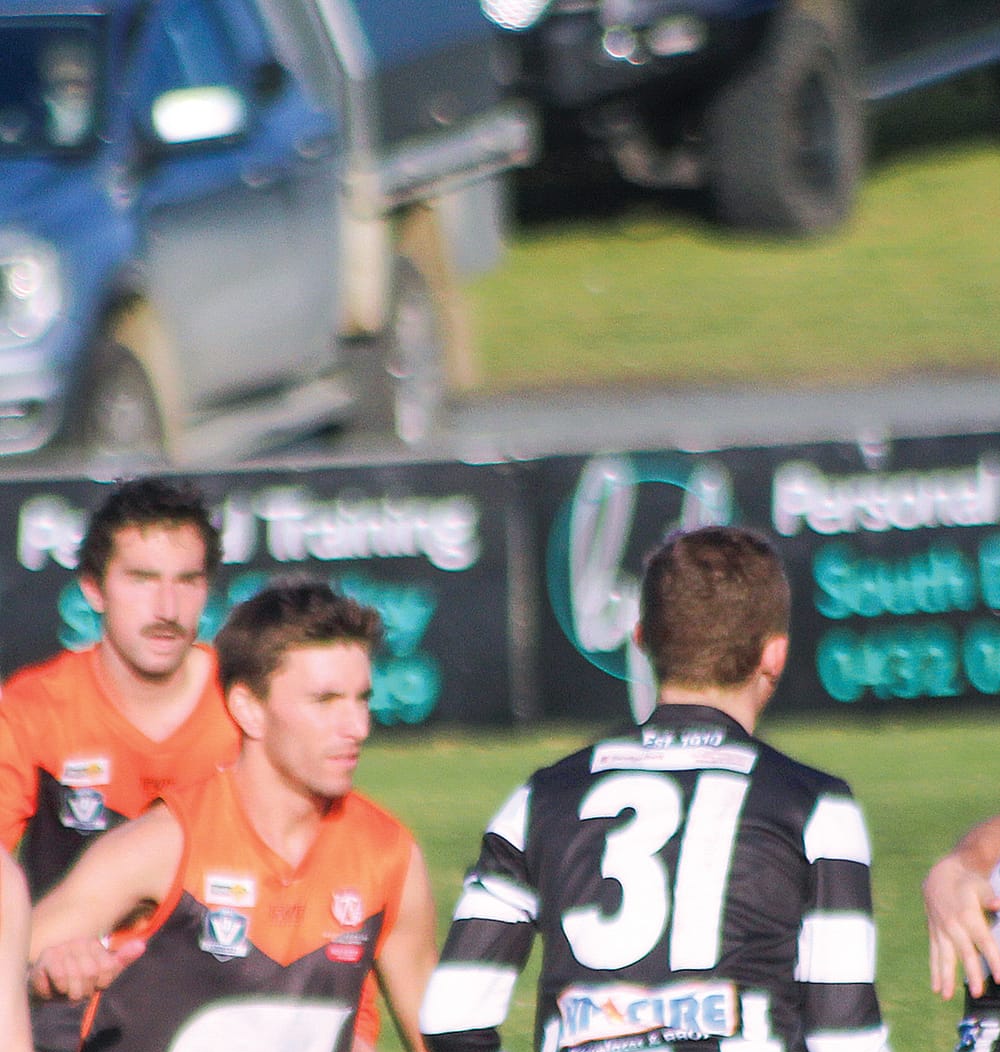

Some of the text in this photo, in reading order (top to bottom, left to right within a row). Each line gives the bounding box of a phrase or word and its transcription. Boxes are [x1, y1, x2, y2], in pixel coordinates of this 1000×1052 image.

[254, 487, 481, 571] Training
[813, 541, 976, 619] South
[561, 771, 750, 972] 31
